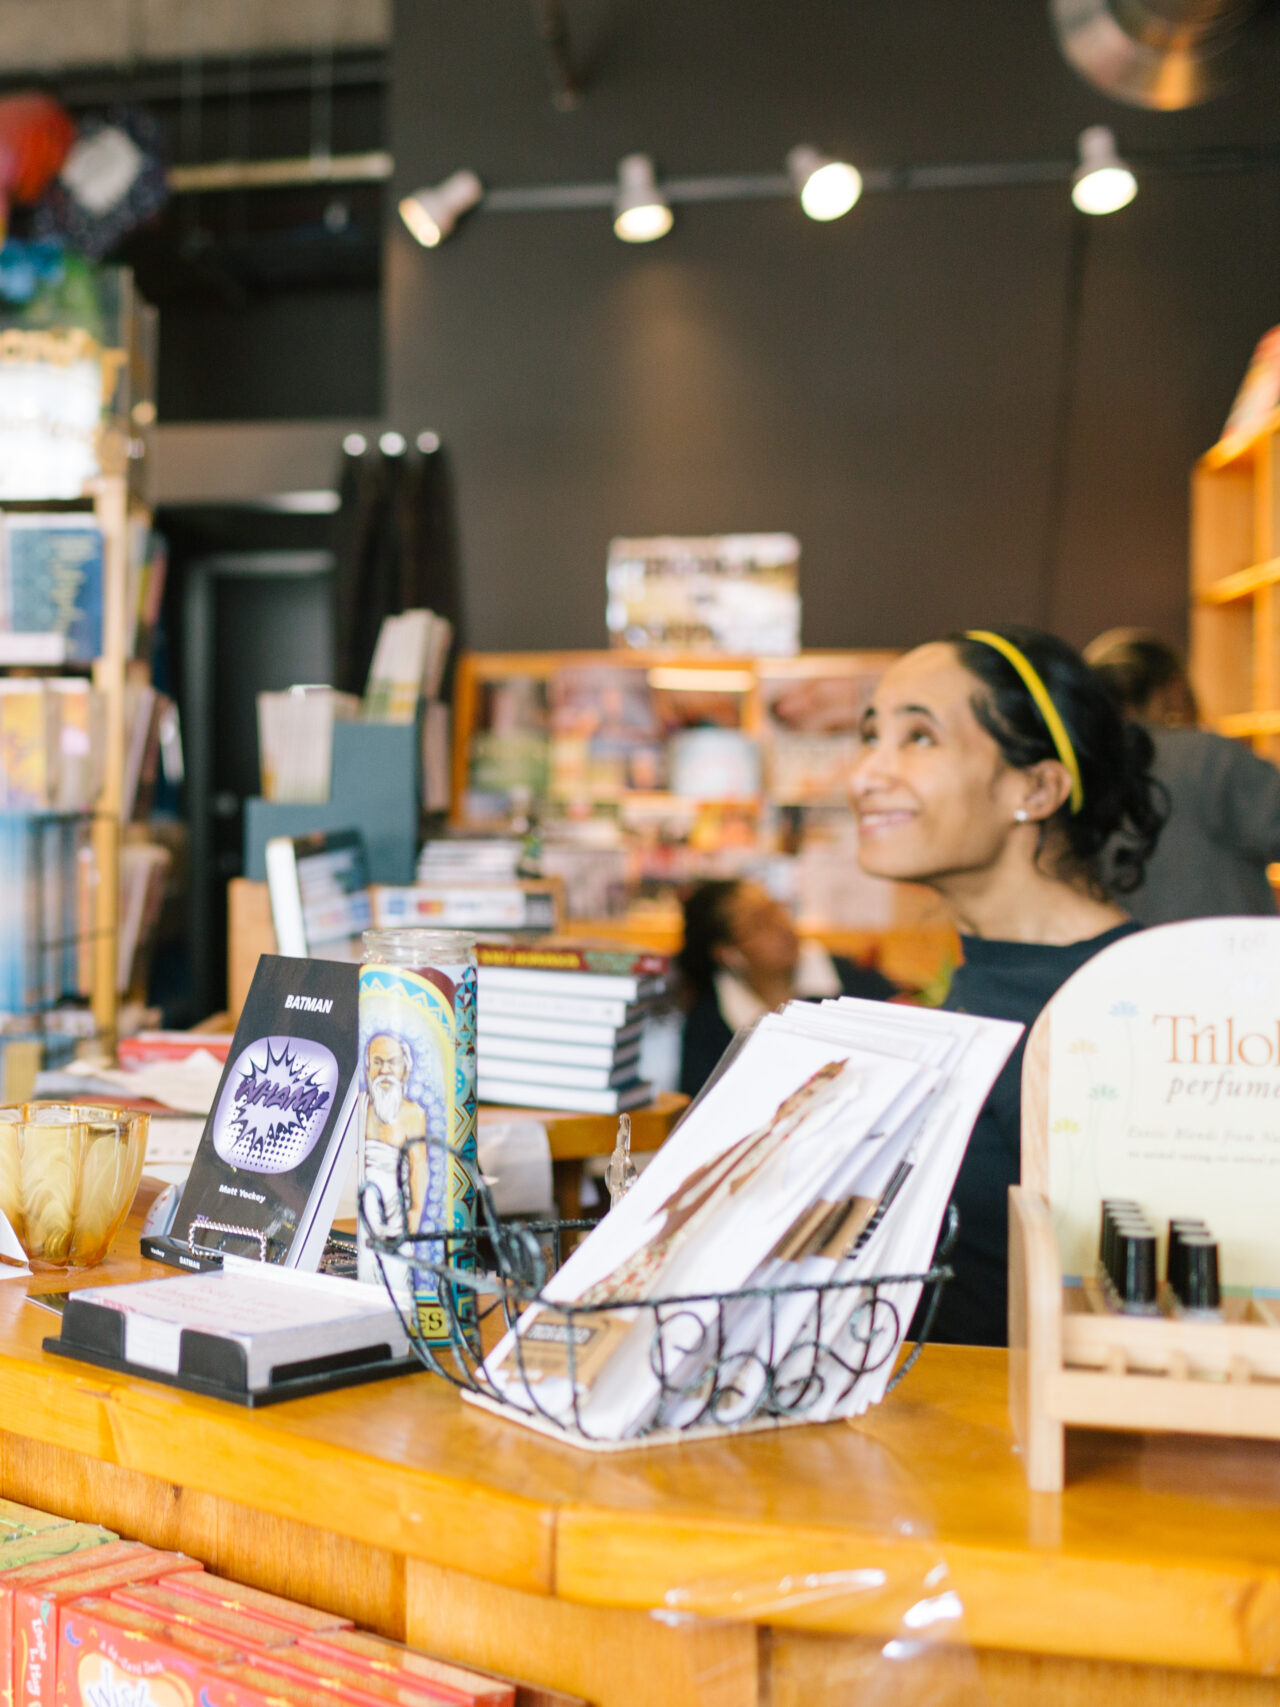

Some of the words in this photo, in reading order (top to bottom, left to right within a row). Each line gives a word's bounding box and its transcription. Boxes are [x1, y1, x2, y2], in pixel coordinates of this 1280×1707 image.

[284, 994, 334, 1014] BATMAN
[234, 1077, 330, 1118] WHAM!
[218, 1184, 238, 1197] Matt
[239, 1189, 266, 1204] Yockey
[179, 1256, 201, 1270] BATMAN
